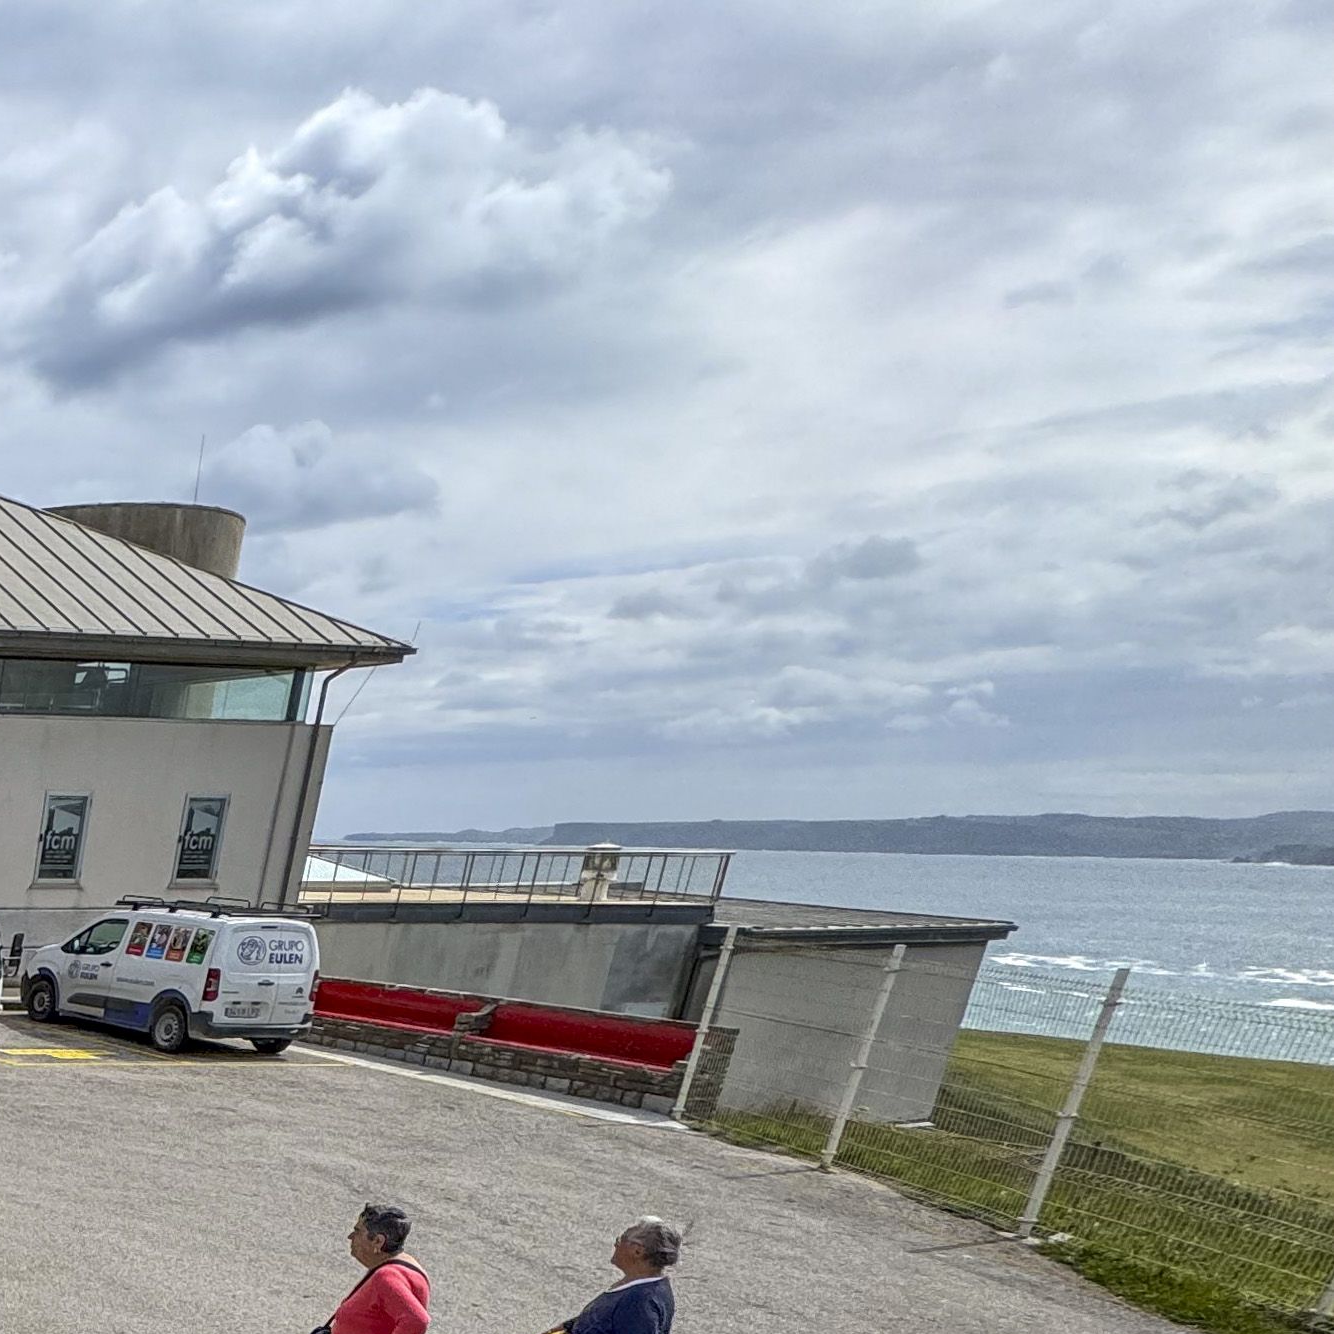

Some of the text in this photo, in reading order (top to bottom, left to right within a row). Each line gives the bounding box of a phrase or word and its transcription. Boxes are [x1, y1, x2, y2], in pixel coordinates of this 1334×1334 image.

[45, 829, 76, 850] fcm
[183, 831, 213, 851] fcm
[269, 939, 305, 952] GRUPO
[268, 953, 303, 965] EULEN
